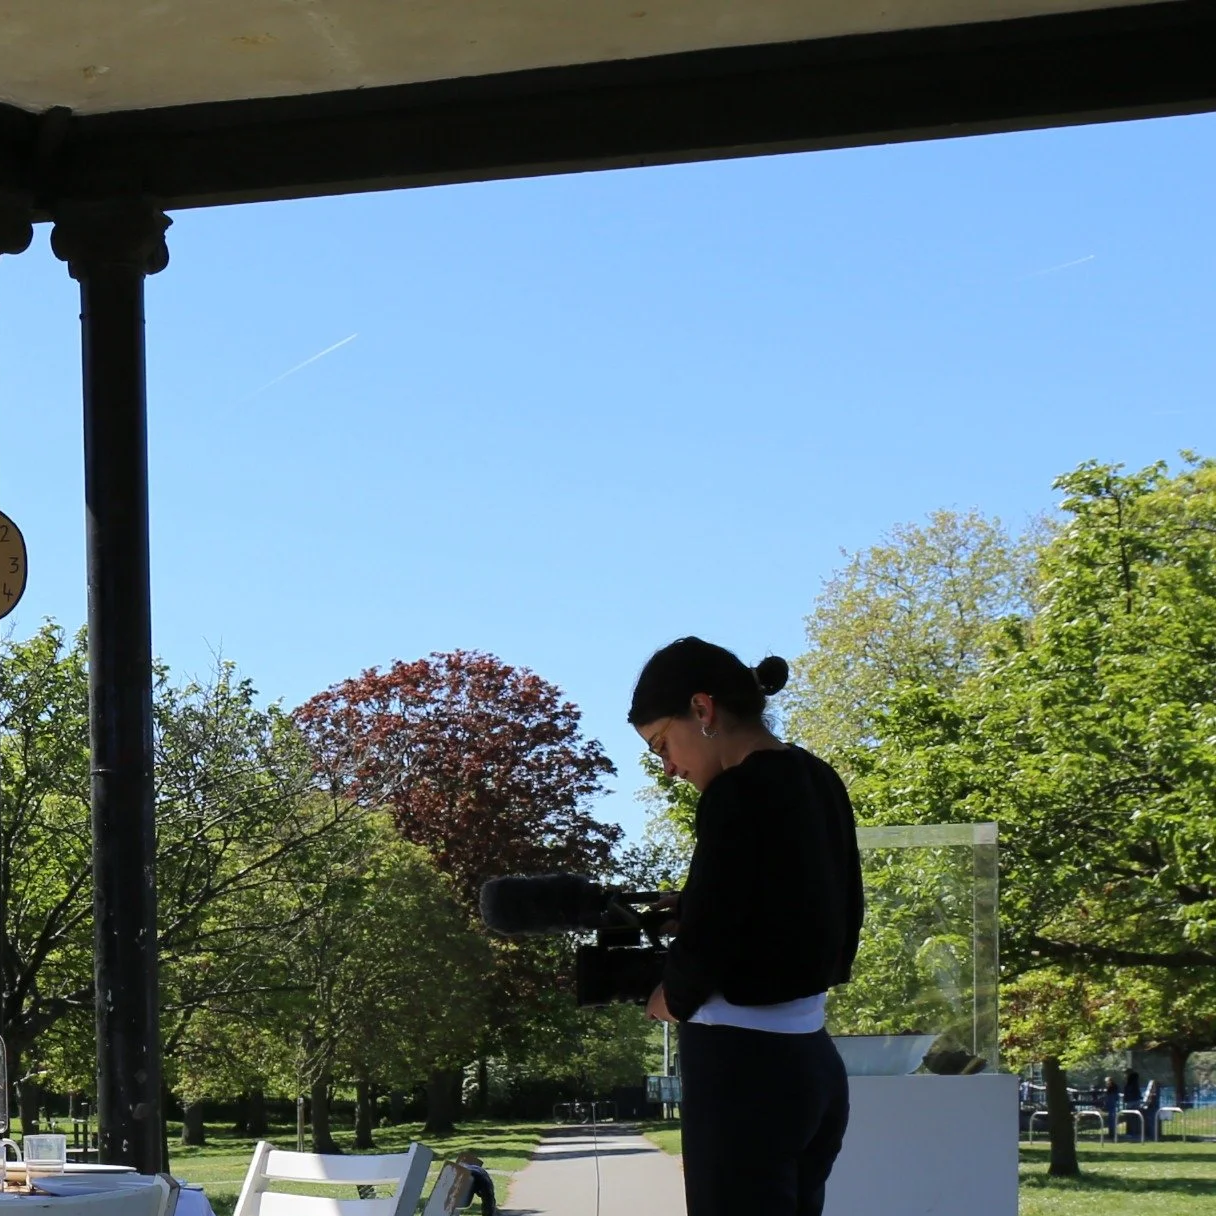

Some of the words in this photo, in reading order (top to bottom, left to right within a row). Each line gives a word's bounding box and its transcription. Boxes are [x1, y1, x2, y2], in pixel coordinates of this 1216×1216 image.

[0, 525, 10, 543] 2
[8, 557, 20, 574] 3
[3, 582, 13, 602] 4
